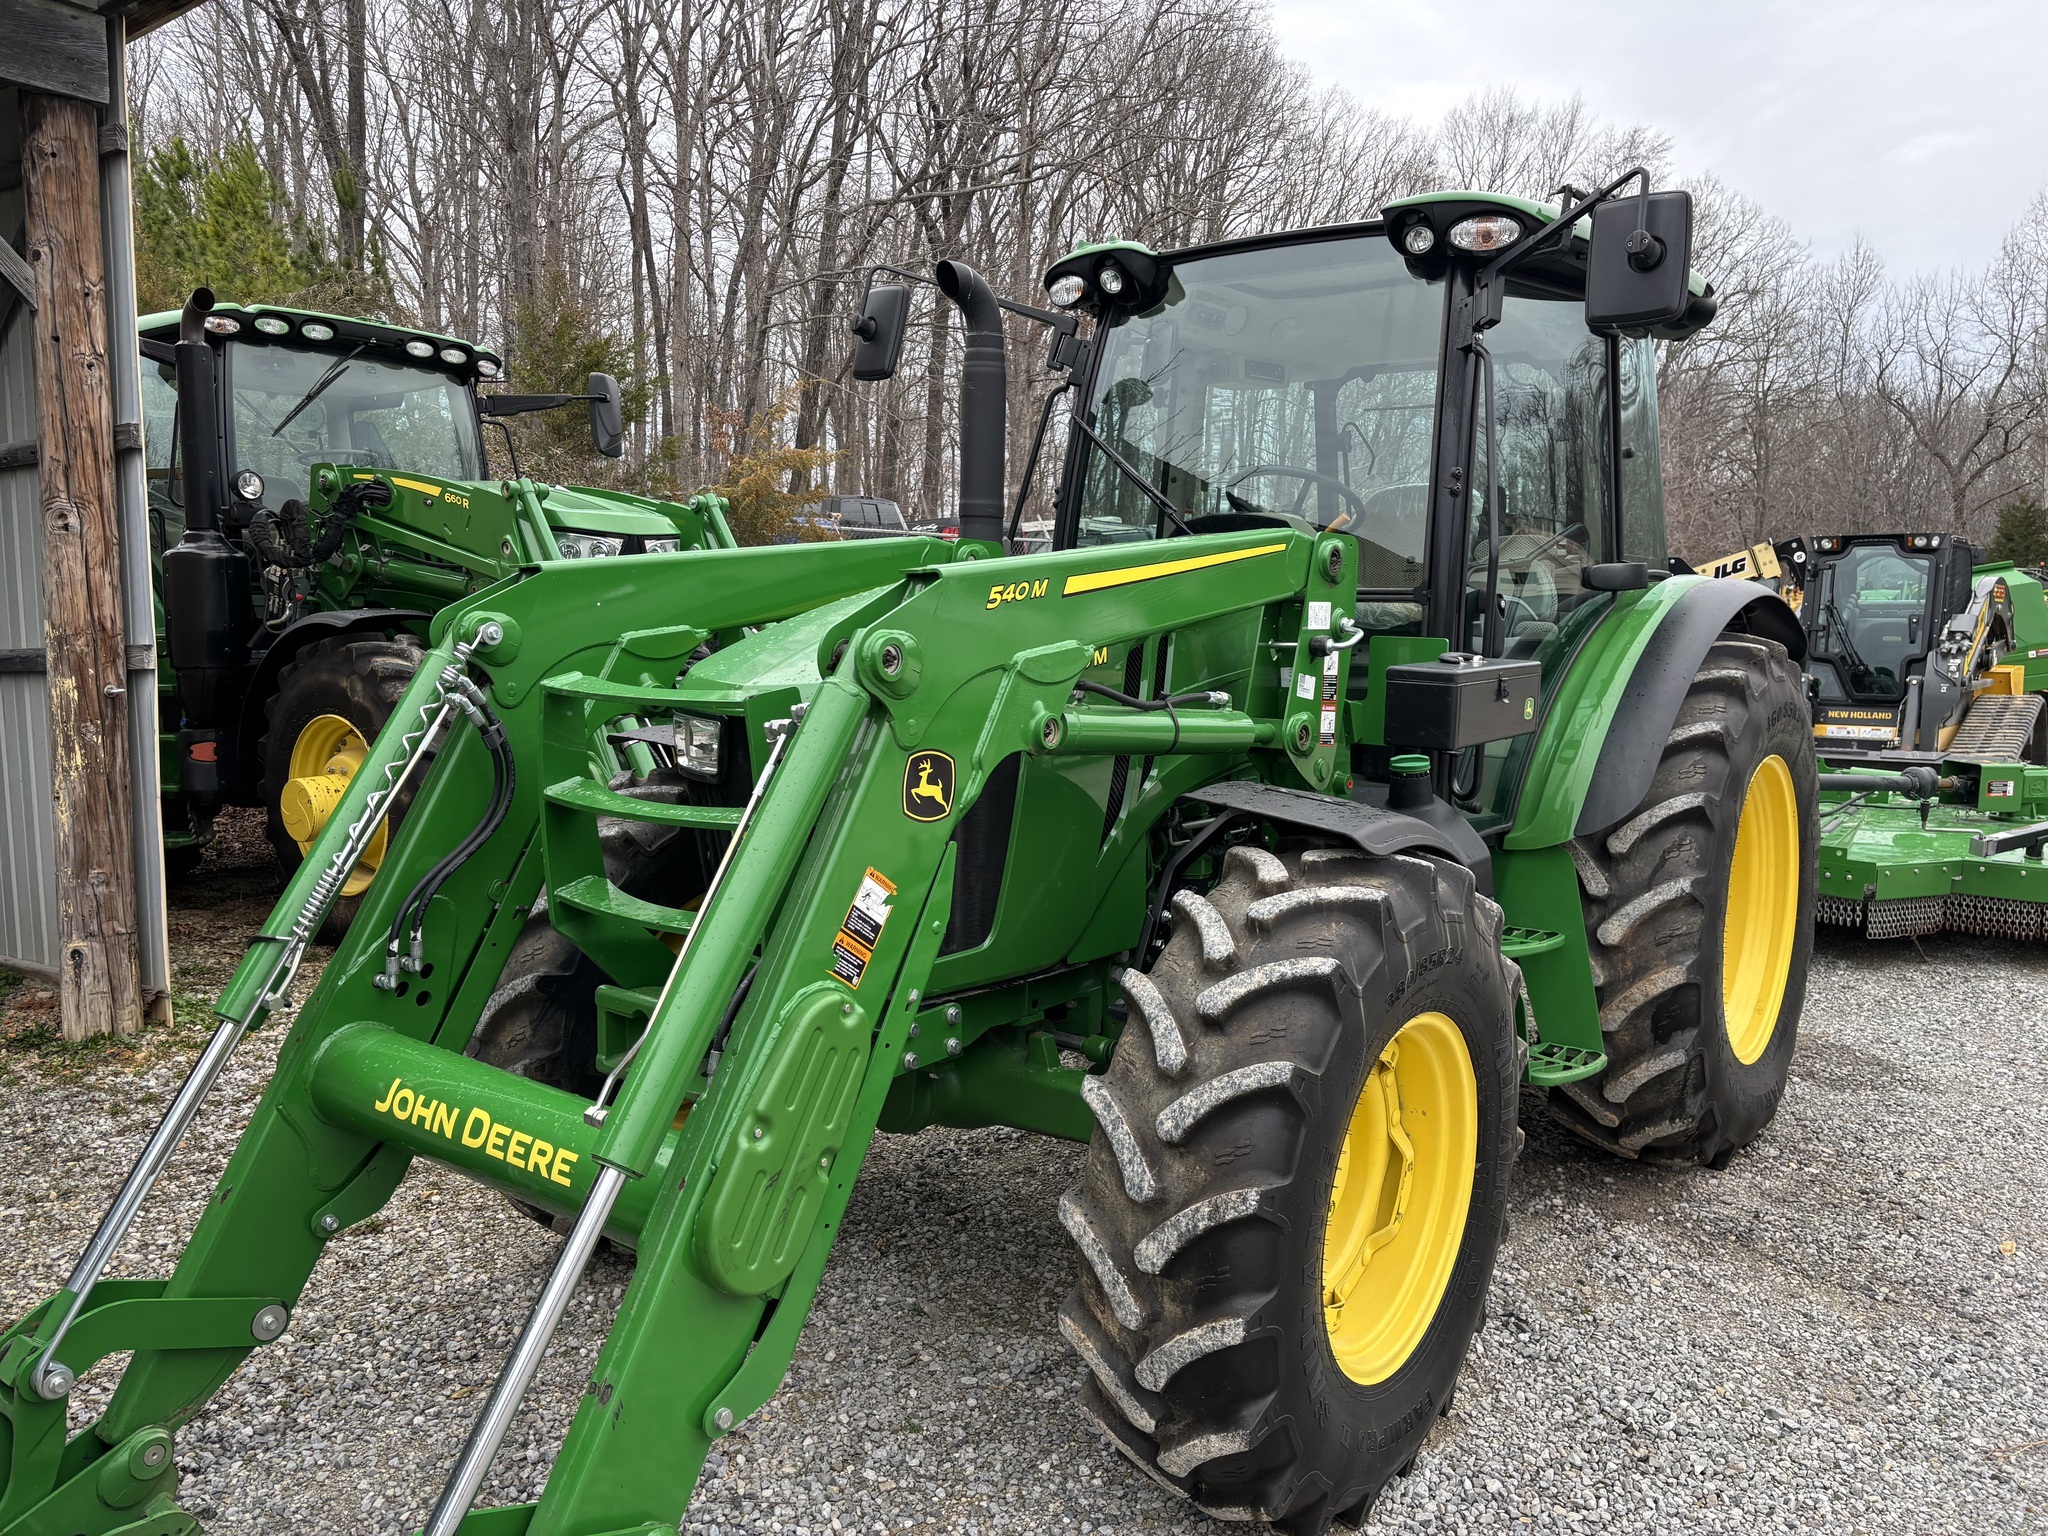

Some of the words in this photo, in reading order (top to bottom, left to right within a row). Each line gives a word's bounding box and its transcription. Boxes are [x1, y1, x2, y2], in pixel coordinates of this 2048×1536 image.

[445, 492, 462, 505] 660
[462, 498, 470, 510] R
[986, 581, 1030, 610] 540
[1030, 577, 1049, 599] M
[1828, 710, 1848, 719] NEW
[1850, 711, 1892, 720] HOLLAND
[845, 940, 867, 959] WARNING
[375, 1077, 460, 1140] JOHN
[461, 1107, 579, 1187] DEERE
